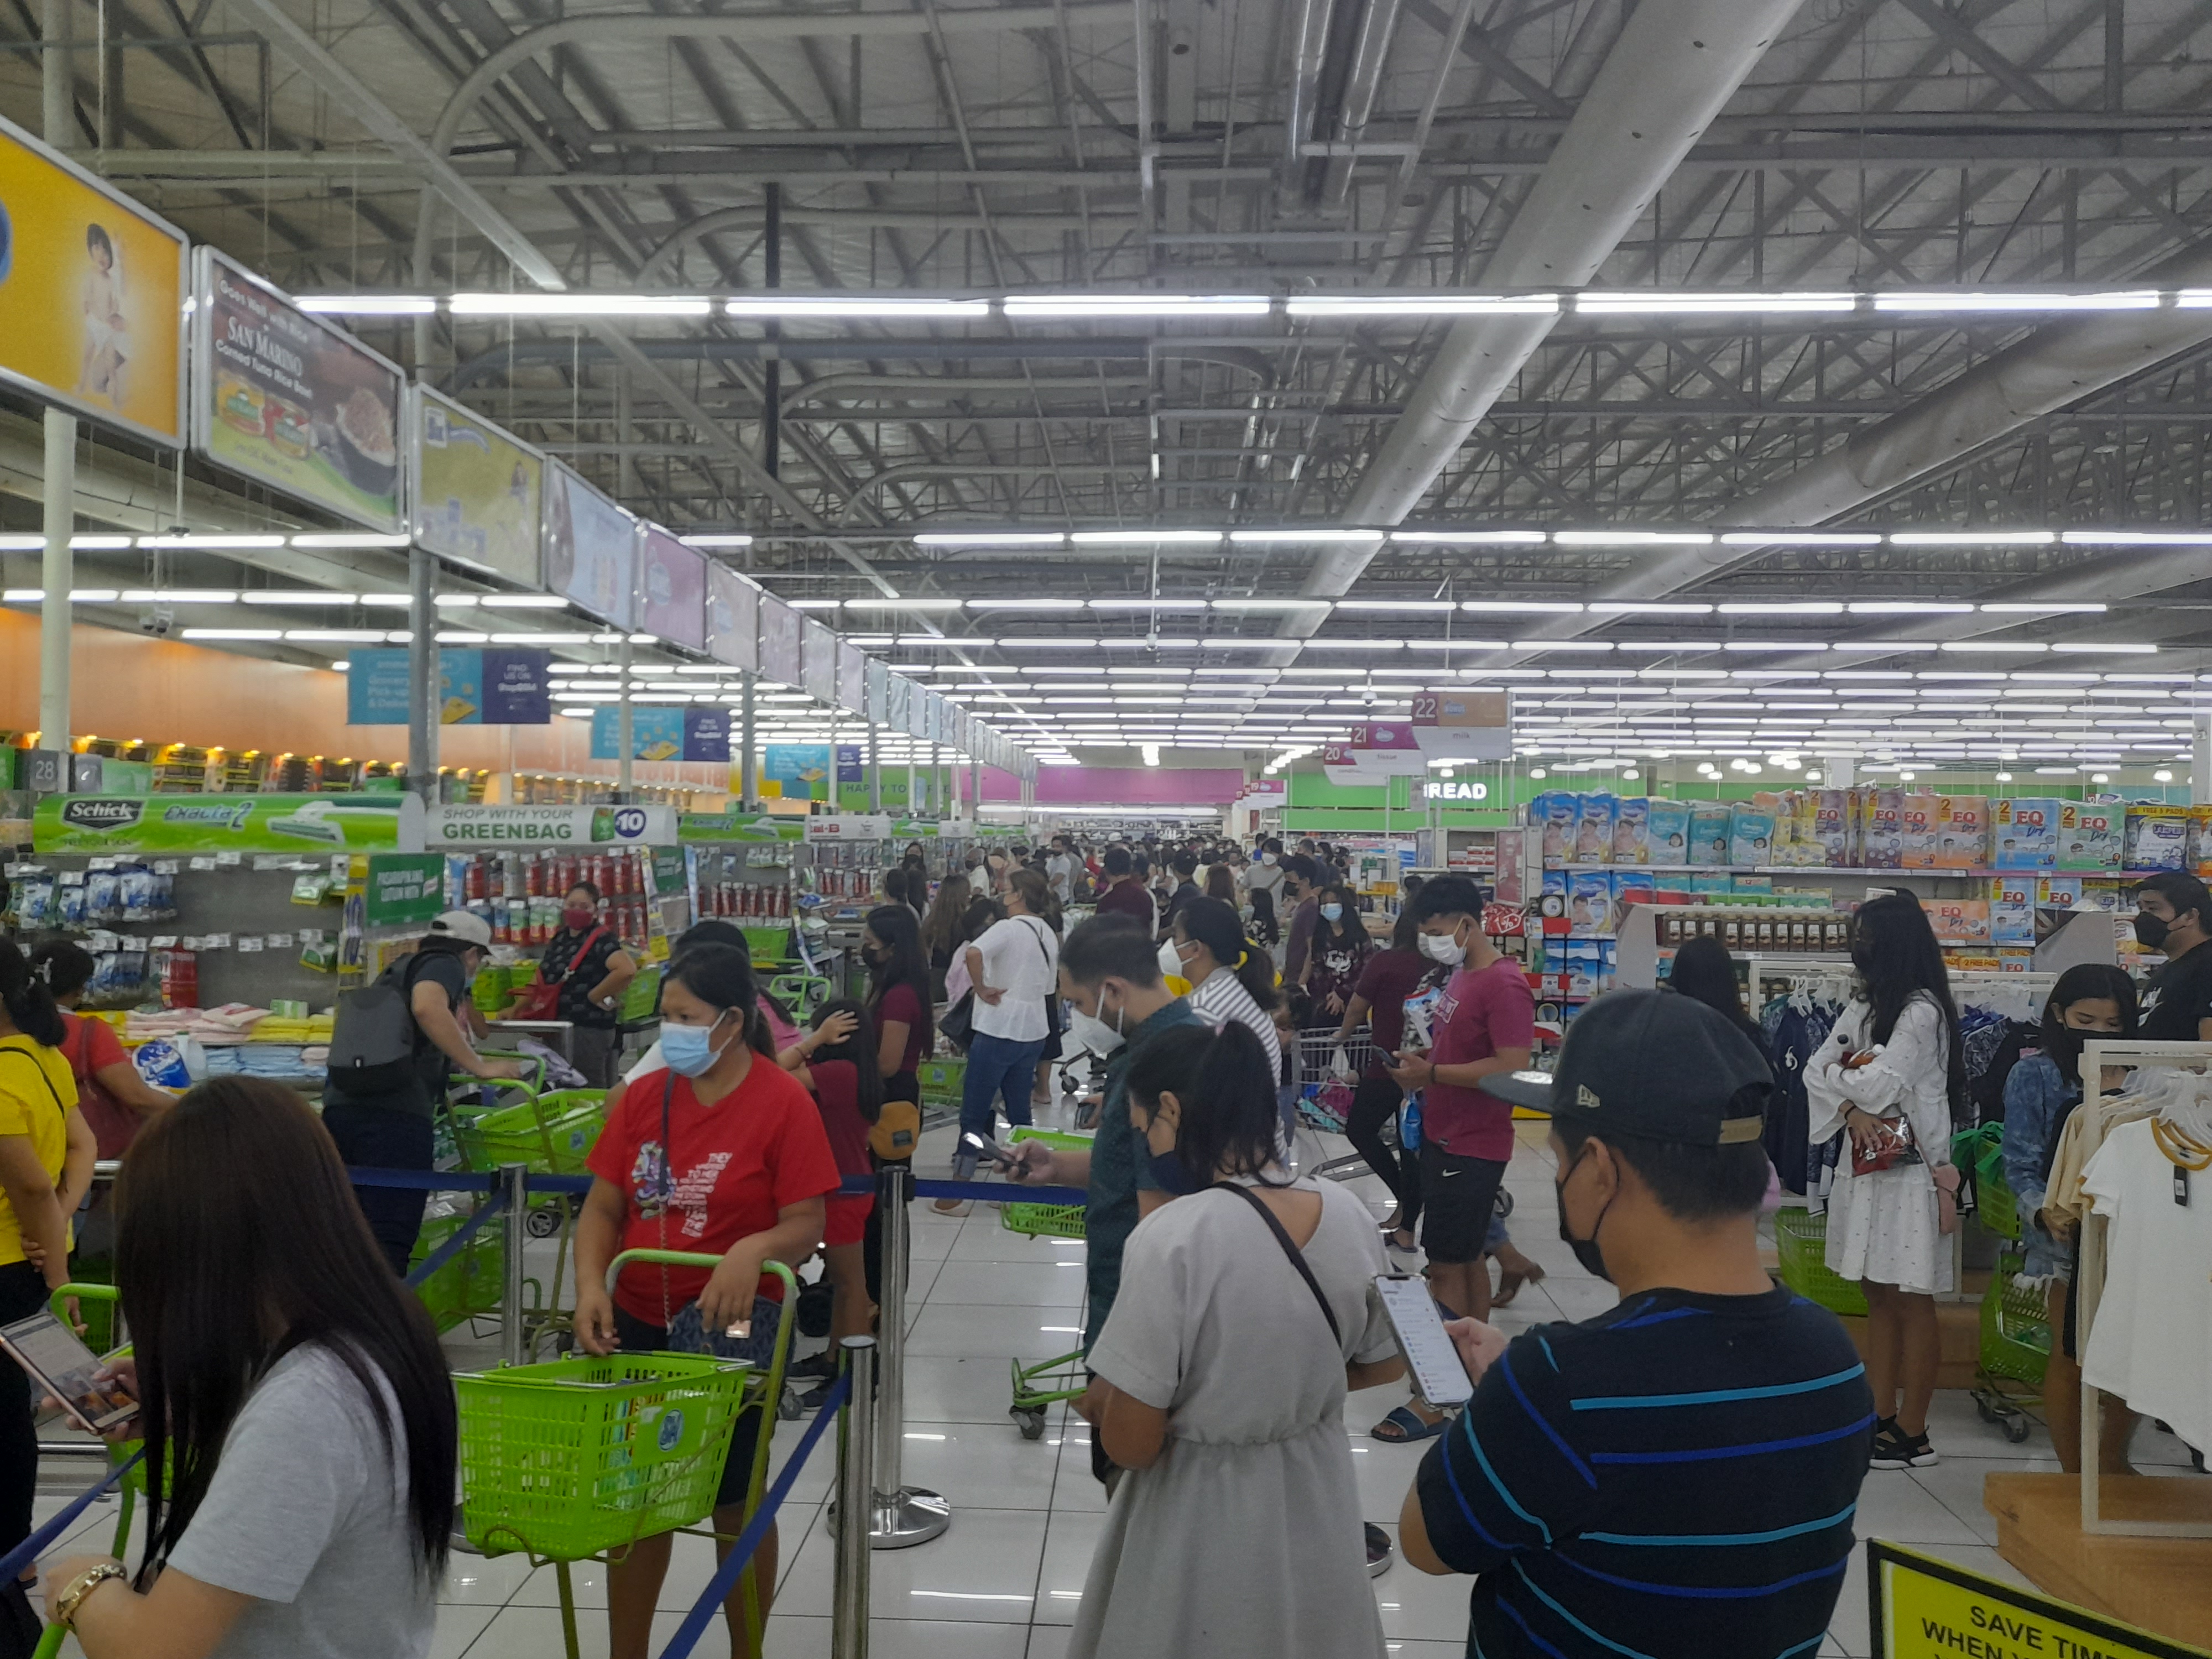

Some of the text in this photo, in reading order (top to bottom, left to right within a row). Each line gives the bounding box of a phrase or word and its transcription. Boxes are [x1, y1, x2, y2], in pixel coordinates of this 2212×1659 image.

[255, 331, 302, 377] MARINO
[1415, 698, 1436, 718] 22
[1353, 727, 1368, 743] 21
[1324, 747, 1340, 760] 20
[35, 760, 55, 780] 28
[847, 784, 886, 794] HAPY
[891, 784, 907, 793] TO
[70, 802, 138, 821] Schick
[1940, 799, 1951, 811] 2
[2000, 800, 2010, 814] 2
[444, 808, 573, 820] SHOP WITH YOUR
[1817, 810, 1839, 821] EQ
[1875, 810, 1897, 822] EQ
[1904, 812, 1926, 825] EQ
[1953, 812, 1976, 825] EQ
[2016, 811, 2044, 826] EQ
[2063, 806, 2075, 821] 2
[2080, 817, 2107, 831] EQ
[442, 823, 572, 840] GREENBAG
[2002, 891, 2026, 904] EQ
[2050, 892, 2073, 905] EQ
[1940, 907, 1961, 918] EQ
[2006, 963, 2024, 972] EQ
[1922, 1617, 2002, 1659] WHEN
[1970, 1605, 2119, 1659] SAVE TIM
